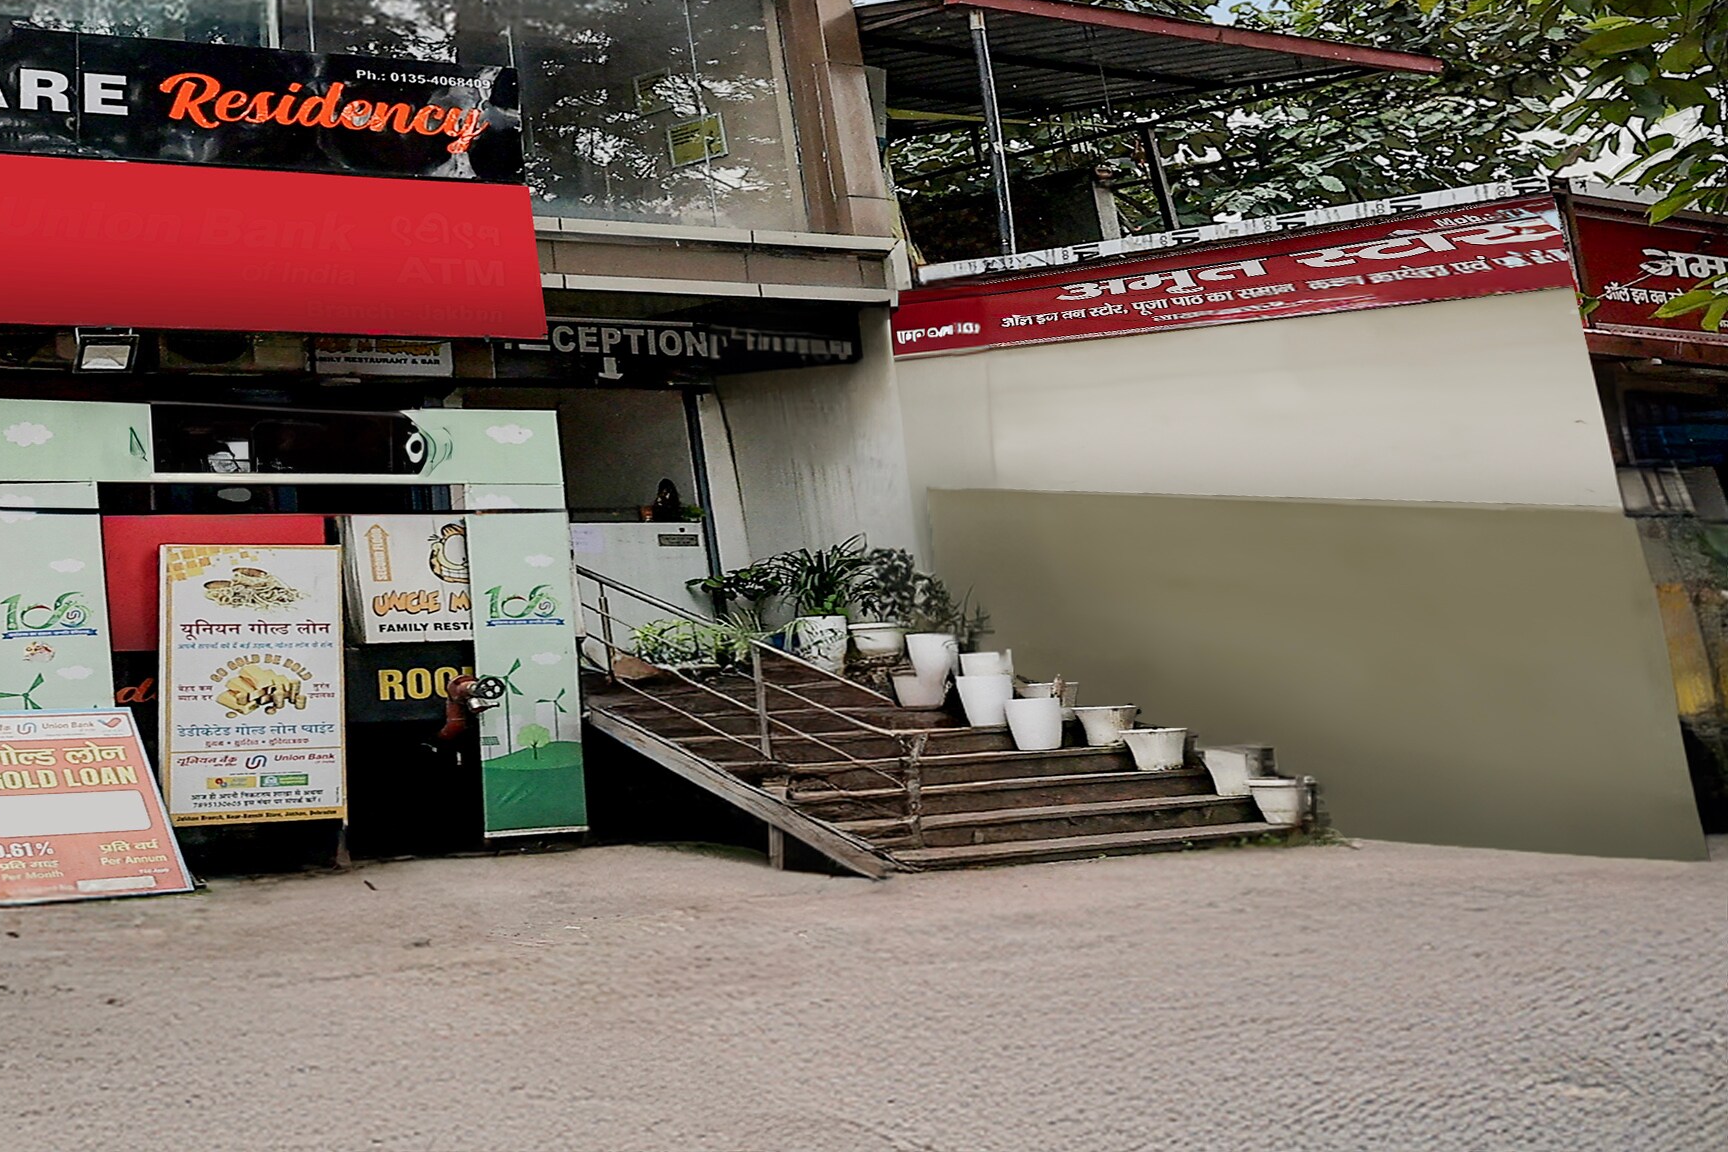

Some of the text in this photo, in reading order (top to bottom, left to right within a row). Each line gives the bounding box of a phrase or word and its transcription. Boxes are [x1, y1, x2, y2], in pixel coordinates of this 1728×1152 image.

[356, 69, 491, 90] Ph.: 0135-4068409
[159, 73, 489, 154] Residency
[518, 324, 707, 358] CEPTION
[373, 590, 441, 617] UNCLE
[180, 618, 332, 640] यूनियन गोल्ड लोन
[379, 623, 429, 633] FAMILY
[227, 653, 260, 671] GOLD
[283, 658, 313, 681] BOLD
[42, 720, 95, 730] Union Bank
[235, 723, 266, 736] गोल्ड
[270, 722, 297, 735] लोन
[62, 740, 126, 764] लोन
[177, 756, 217, 766] यूनियन
[63, 765, 139, 787] LOAN
[101, 853, 168, 866] Per Annum
